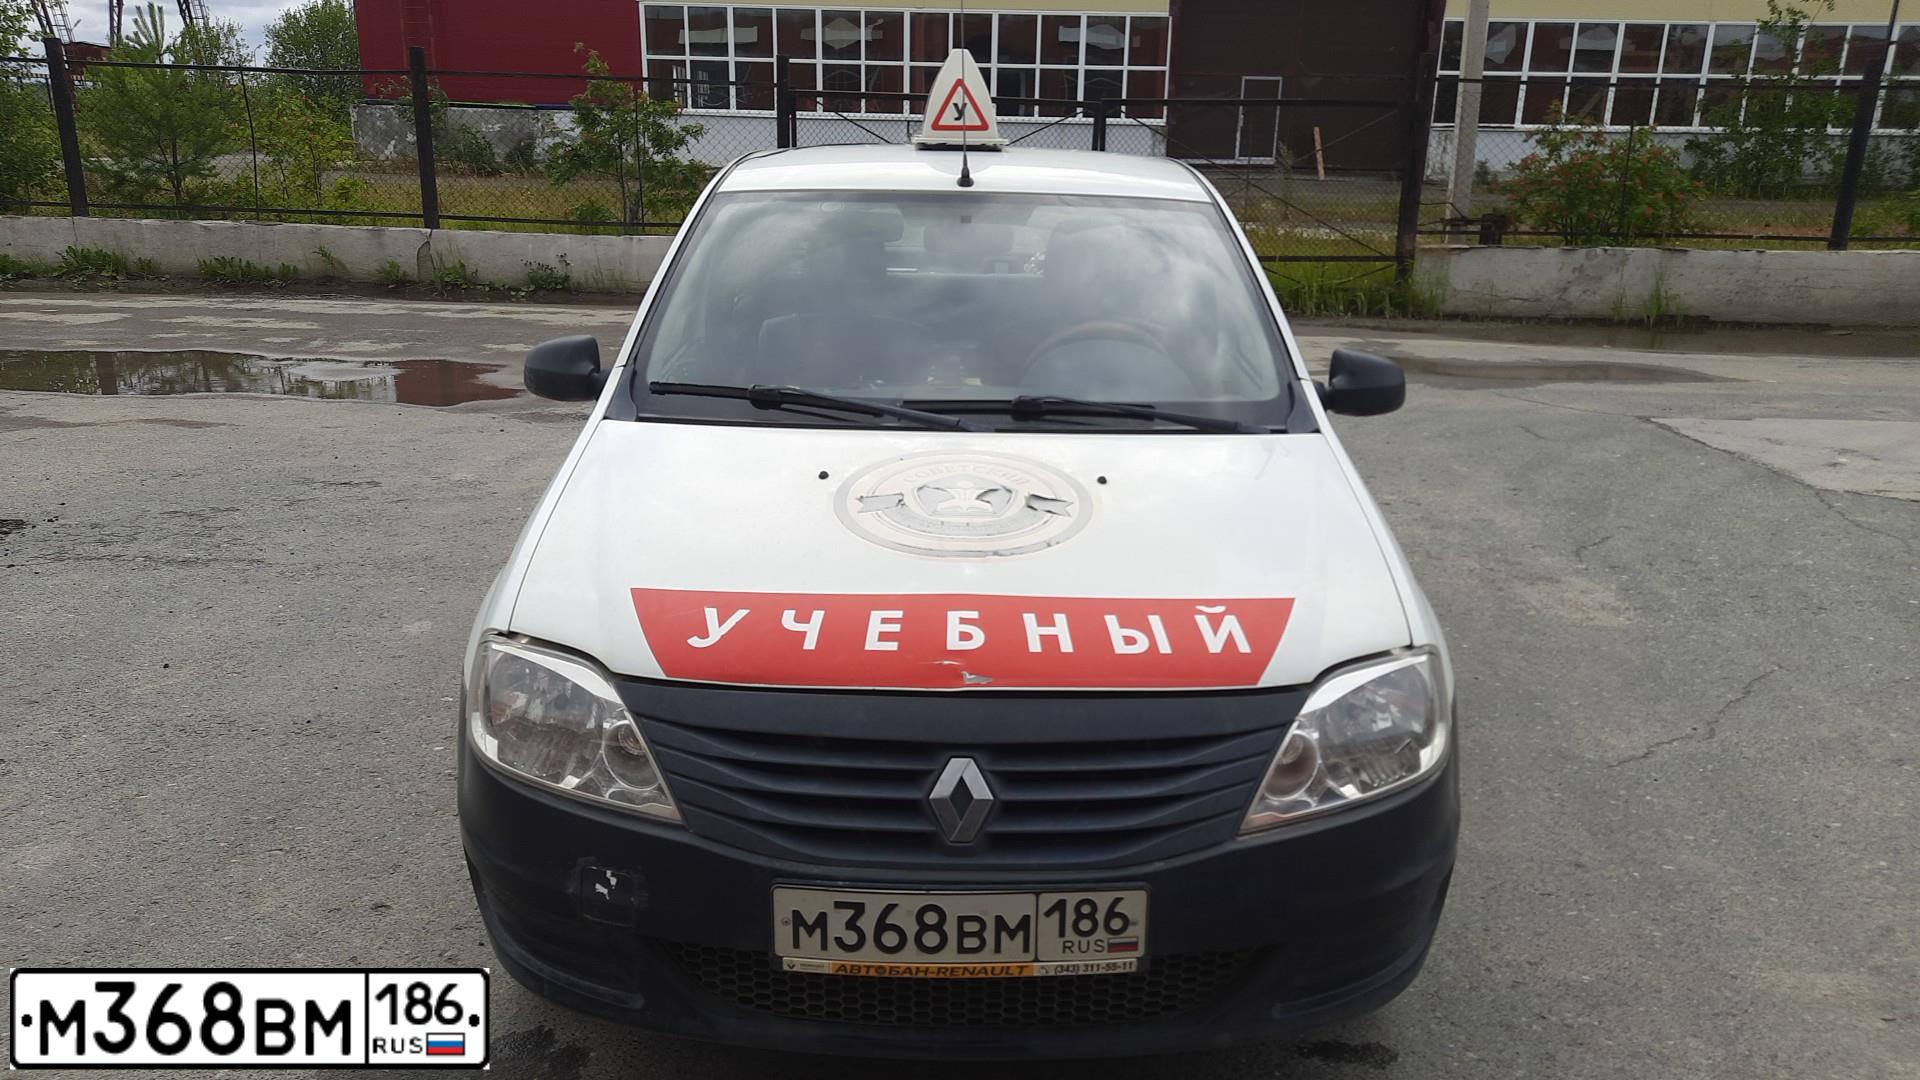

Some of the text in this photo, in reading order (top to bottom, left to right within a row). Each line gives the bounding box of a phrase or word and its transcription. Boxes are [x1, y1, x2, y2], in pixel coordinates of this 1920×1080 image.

[952, 102, 968, 120] У
[686, 604, 1252, 656] УЧЕБНЫЙ
[791, 896, 1130, 955] М368ВМ 186
[1061, 938, 1105, 954] RUS
